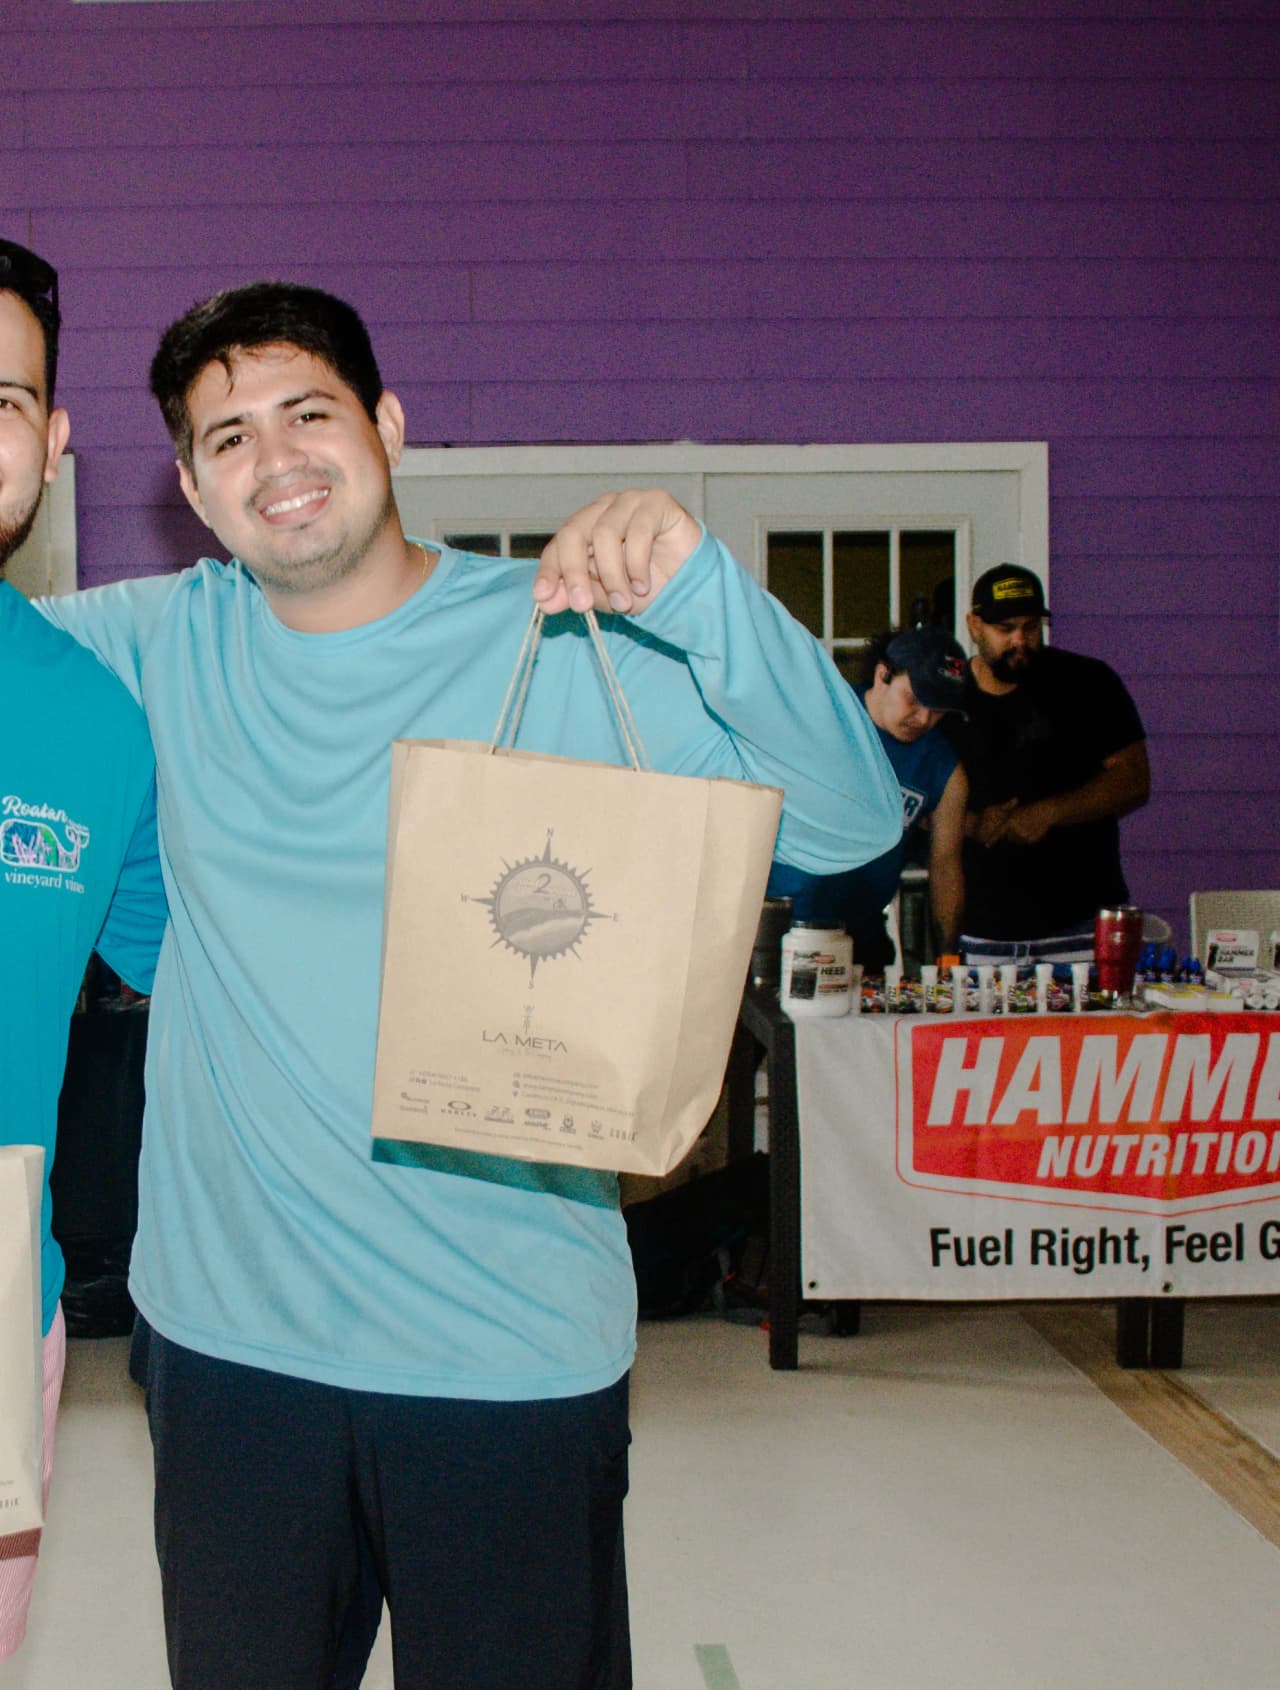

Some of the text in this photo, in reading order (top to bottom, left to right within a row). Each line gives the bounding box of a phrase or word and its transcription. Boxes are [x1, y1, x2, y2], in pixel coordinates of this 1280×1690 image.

[4, 868, 62, 889] vineyard
[532, 873, 552, 894] 2
[482, 1029, 508, 1044] LA
[514, 1034, 568, 1054] META
[929, 1227, 1014, 1267] Fuel
[1030, 1226, 1150, 1275] Right,
[1164, 1222, 1244, 1265] Feel
